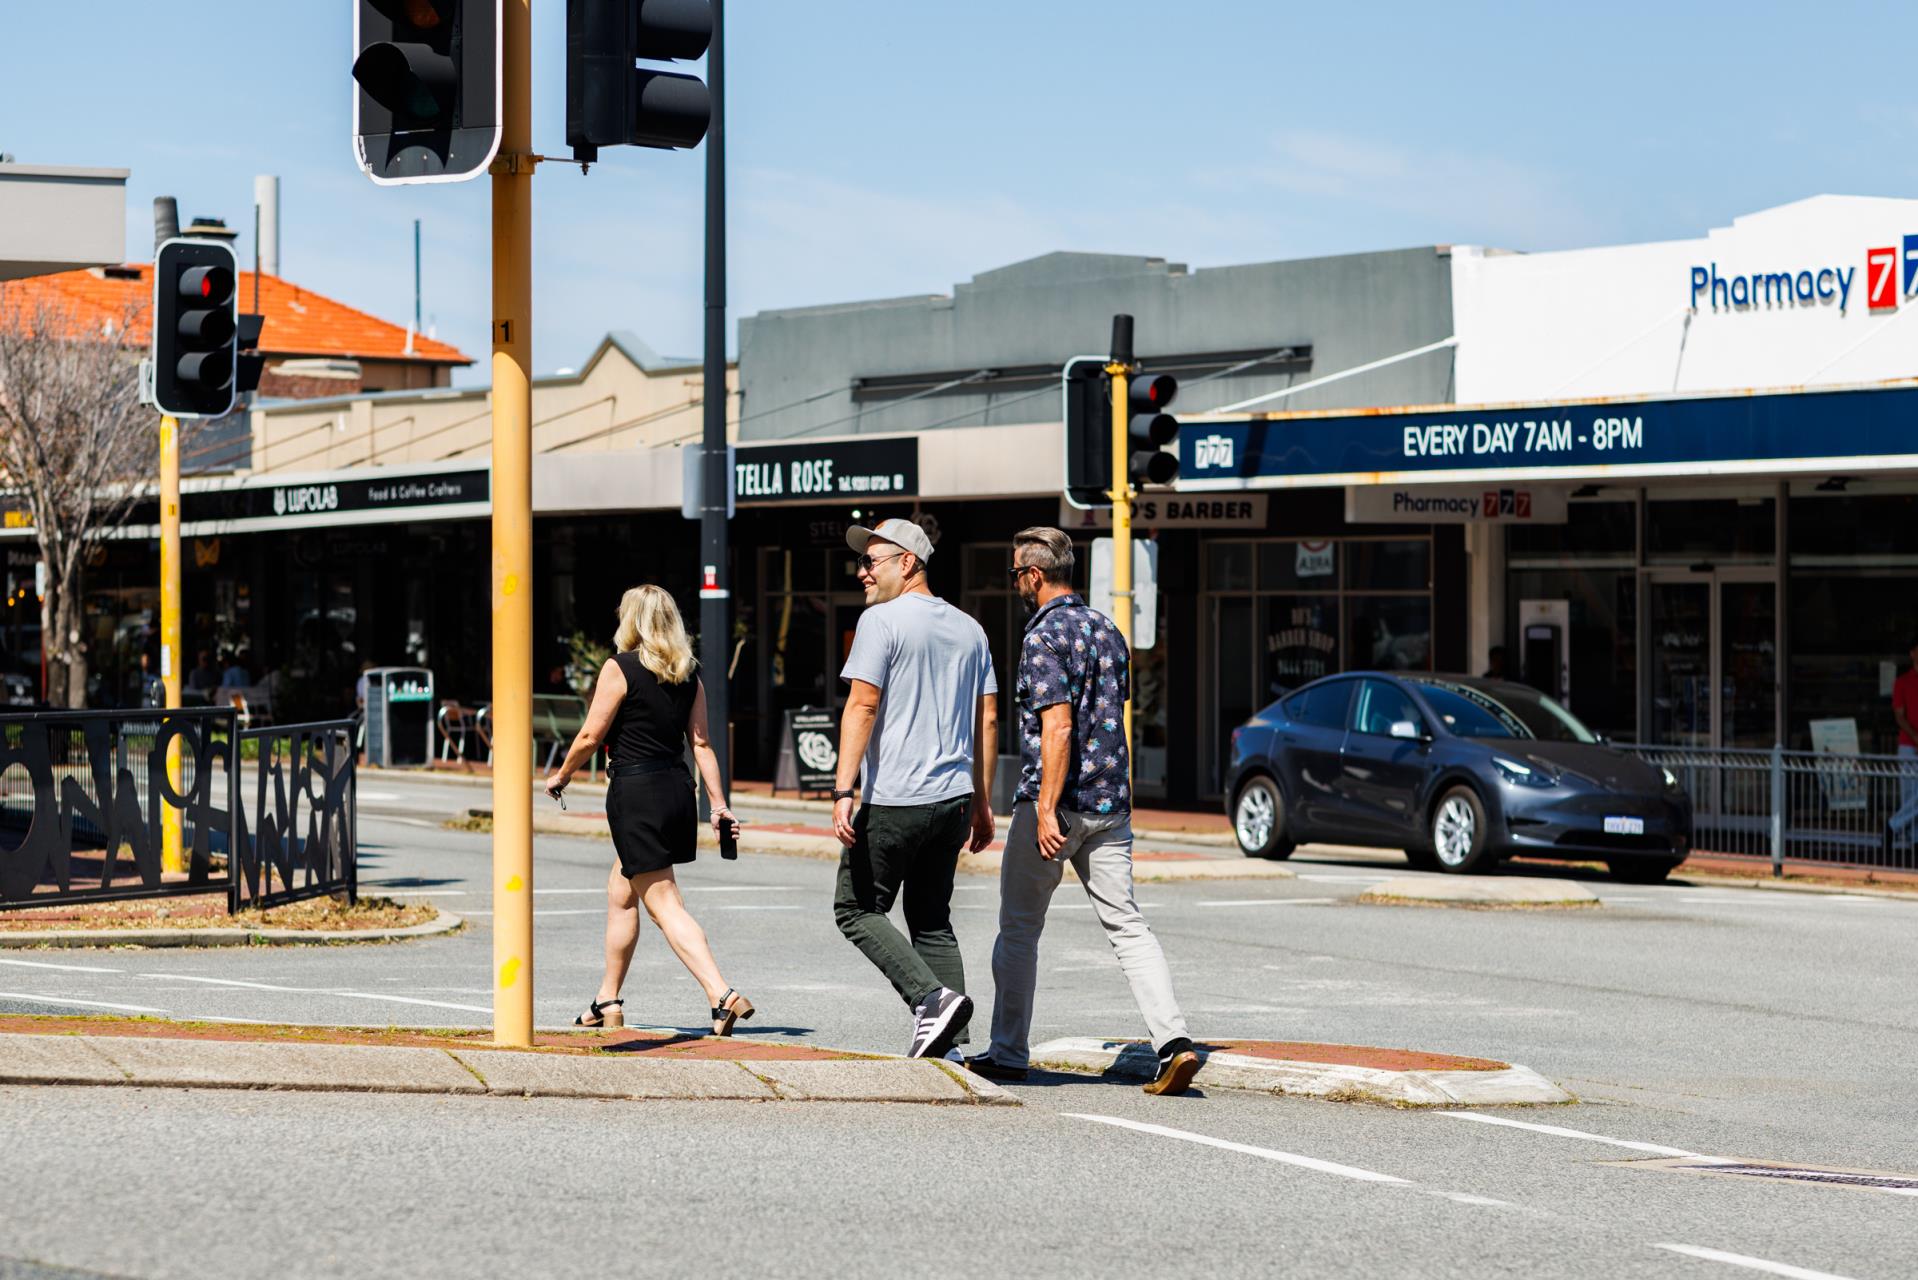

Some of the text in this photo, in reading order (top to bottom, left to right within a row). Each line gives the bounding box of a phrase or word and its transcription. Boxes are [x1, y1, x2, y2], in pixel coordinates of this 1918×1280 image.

[1691, 262, 1854, 310] Pharmacy
[1197, 438, 1232, 467] 777
[1403, 425, 1468, 457] EVERY
[1473, 422, 1519, 455] DAY
[1523, 419, 1572, 452] 7AM
[1593, 416, 1643, 450] 8PM
[735, 462, 784, 496] TELLA
[790, 459, 833, 493] ROSE
[287, 480, 462, 512] LUPOLAB Food & Coffee Crafters
[1167, 501, 1253, 520] BARBER
[1393, 492, 1530, 520] Pharmacy 777
